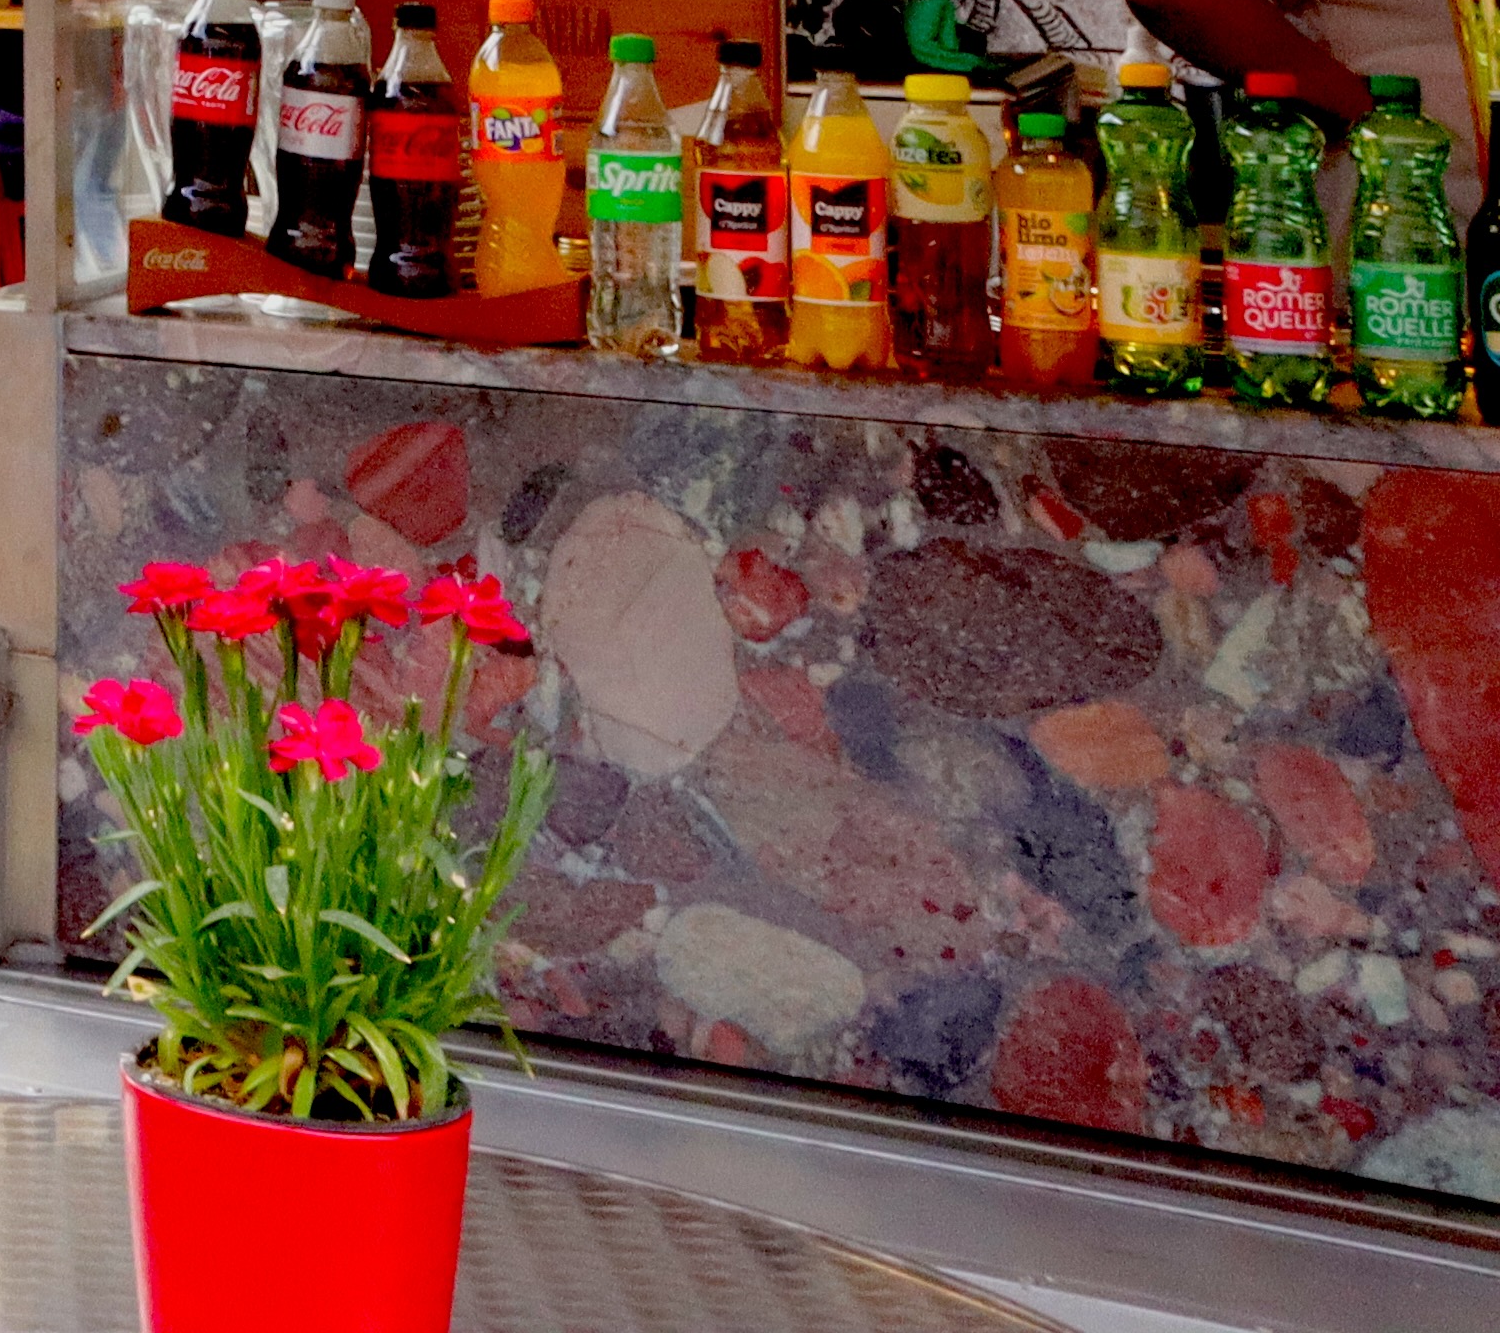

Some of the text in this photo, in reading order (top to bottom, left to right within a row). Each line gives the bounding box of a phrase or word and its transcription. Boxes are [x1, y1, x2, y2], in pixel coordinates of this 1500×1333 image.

[484, 115, 541, 141] FANTA
[713, 197, 762, 218] Cappy
[814, 201, 864, 222] Cappy
[1017, 212, 1051, 231] bio
[1243, 309, 1325, 332] QUELLE
[1367, 316, 1454, 339] QUELLE
